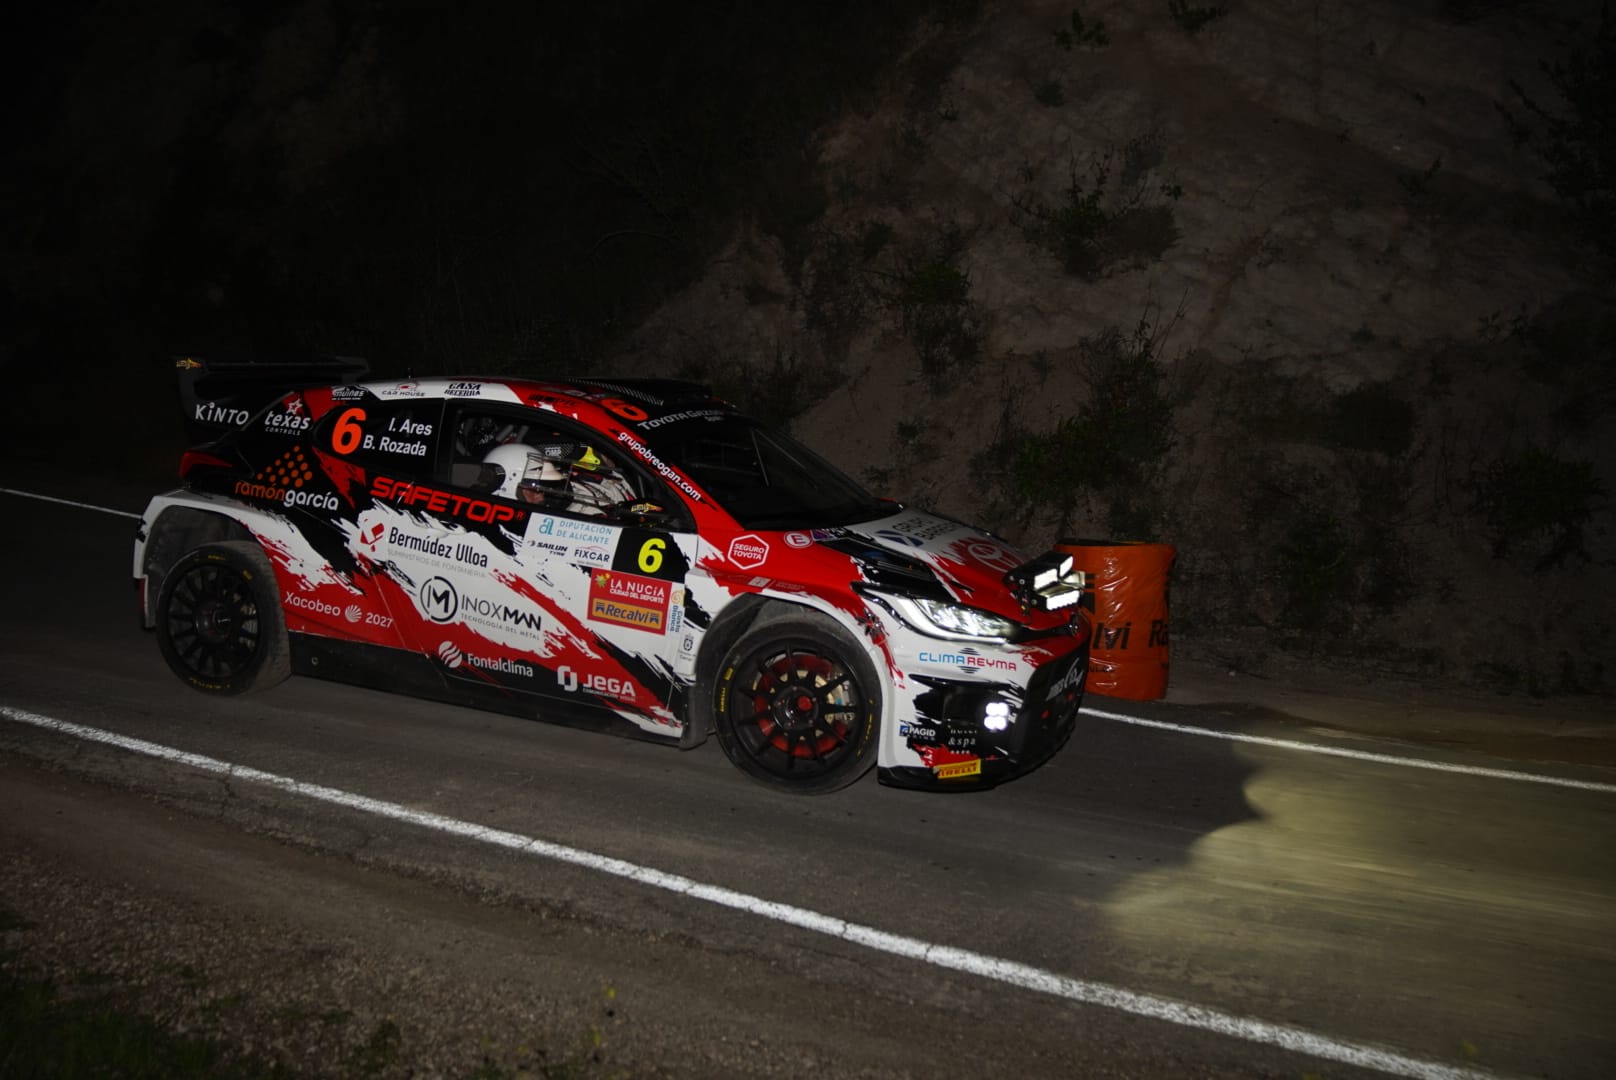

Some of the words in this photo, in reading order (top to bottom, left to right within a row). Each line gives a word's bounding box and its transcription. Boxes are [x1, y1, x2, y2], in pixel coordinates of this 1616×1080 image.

[601, 397, 650, 422] 6
[264, 410, 311, 430] texas
[388, 417, 397, 432] I.
[399, 418, 433, 436] Ares
[637, 412, 688, 431] TOYOTA
[331, 406, 367, 455] 6
[363, 434, 376, 450] B.
[379, 436, 427, 457] Rozada
[618, 432, 702, 502] grupobreogan.com
[556, 529, 567, 537] DE
[568, 531, 609, 545] ALICANTE
[559, 520, 613, 535] DIPUTACIÓN
[389, 527, 452, 558] Bermúdez
[455, 543, 488, 568] Ulloa
[536, 541, 568, 552] SAILUN
[574, 548, 610, 563] FIXCAR
[637, 537, 667, 574] 6
[733, 543, 765, 554] SEGURO
[733, 550, 763, 561] TOYOTA
[610, 578, 622, 590] LA
[285, 591, 341, 616] Xacobeo
[364, 612, 394, 629] 2027
[461, 594, 541, 631] INOXMAN
[605, 603, 650, 623] Recalvi
[505, 626, 517, 634] DEL
[520, 631, 540, 641] METAL
[466, 653, 533, 678] Fontalclima
[909, 727, 936, 737] PAGID
